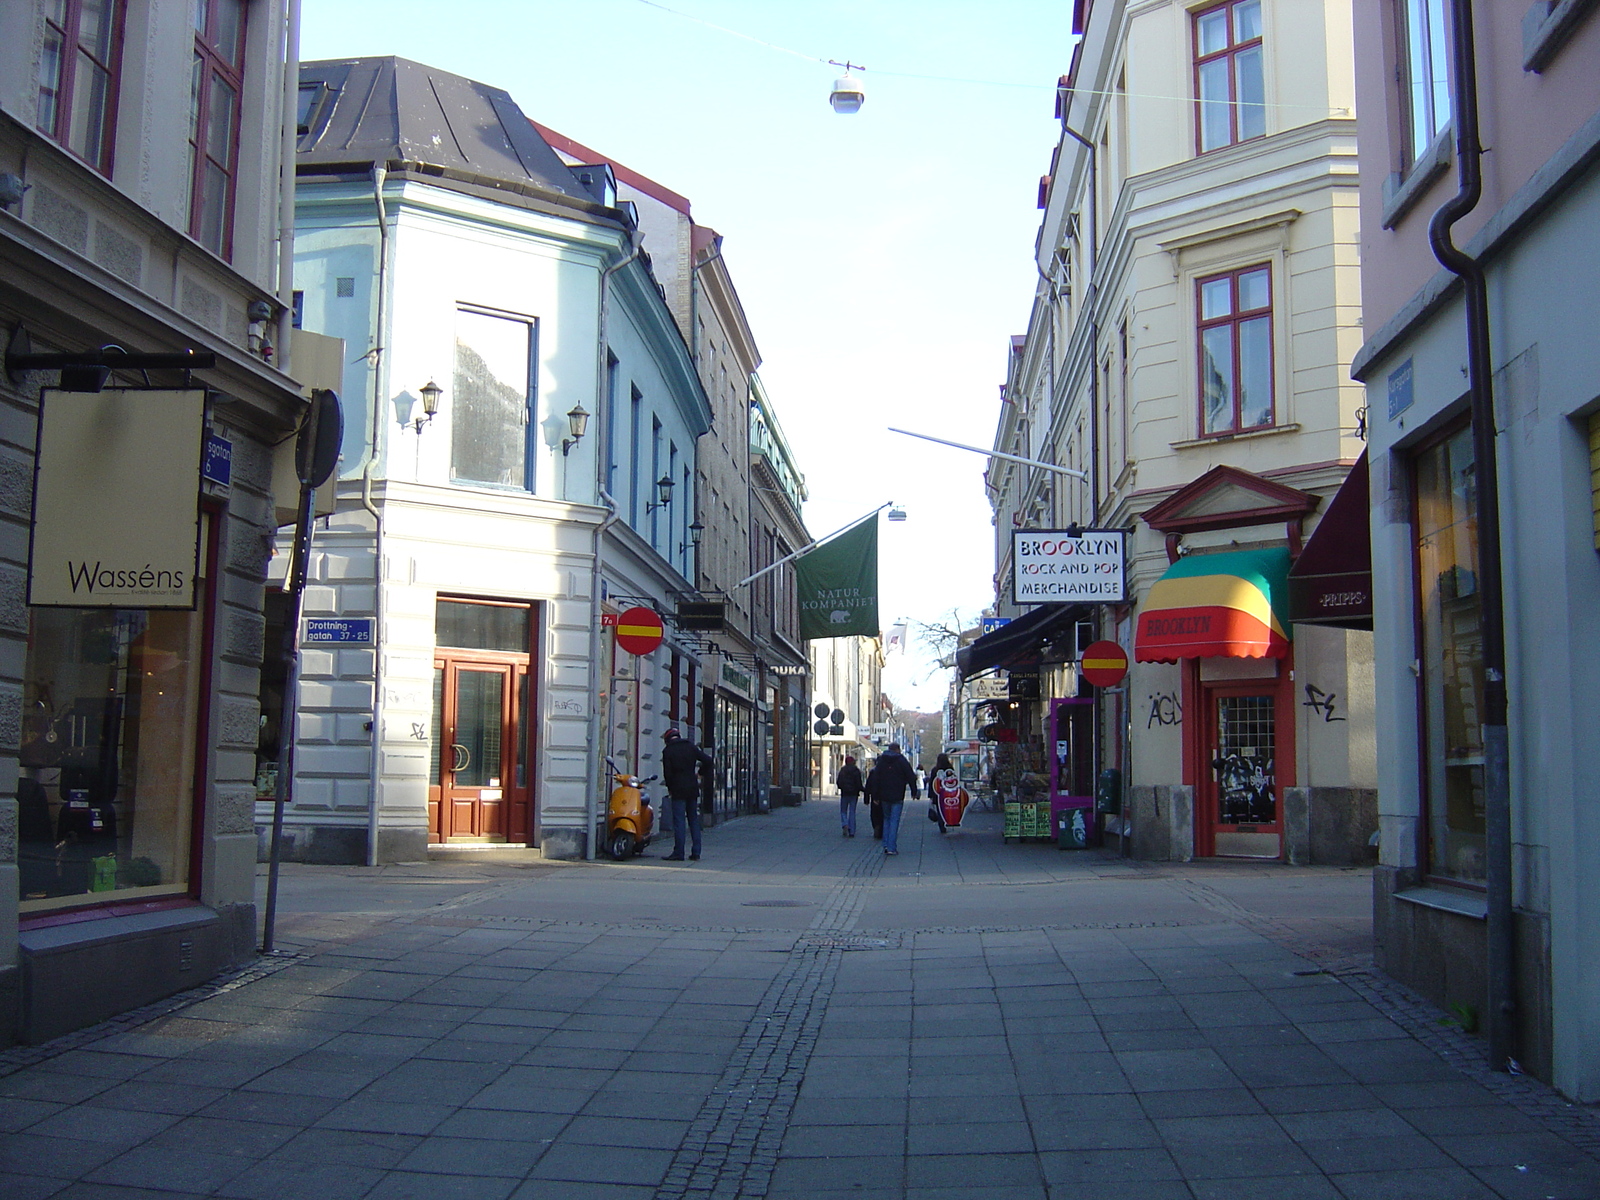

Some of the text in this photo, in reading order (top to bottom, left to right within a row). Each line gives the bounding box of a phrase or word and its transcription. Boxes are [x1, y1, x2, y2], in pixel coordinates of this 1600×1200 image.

[208, 441, 230, 461] sgatan
[1021, 540, 1117, 556] BROOKLYN
[1021, 563, 1118, 575] ROCK AND POP
[68, 561, 183, 593] Wasséns
[817, 588, 860, 598] NATUR
[1021, 582, 1118, 594] MERCHANDISE
[802, 597, 876, 610] KOMPANIET
[1146, 616, 1212, 637] BROOKLYN
[308, 632, 333, 641] gatan
